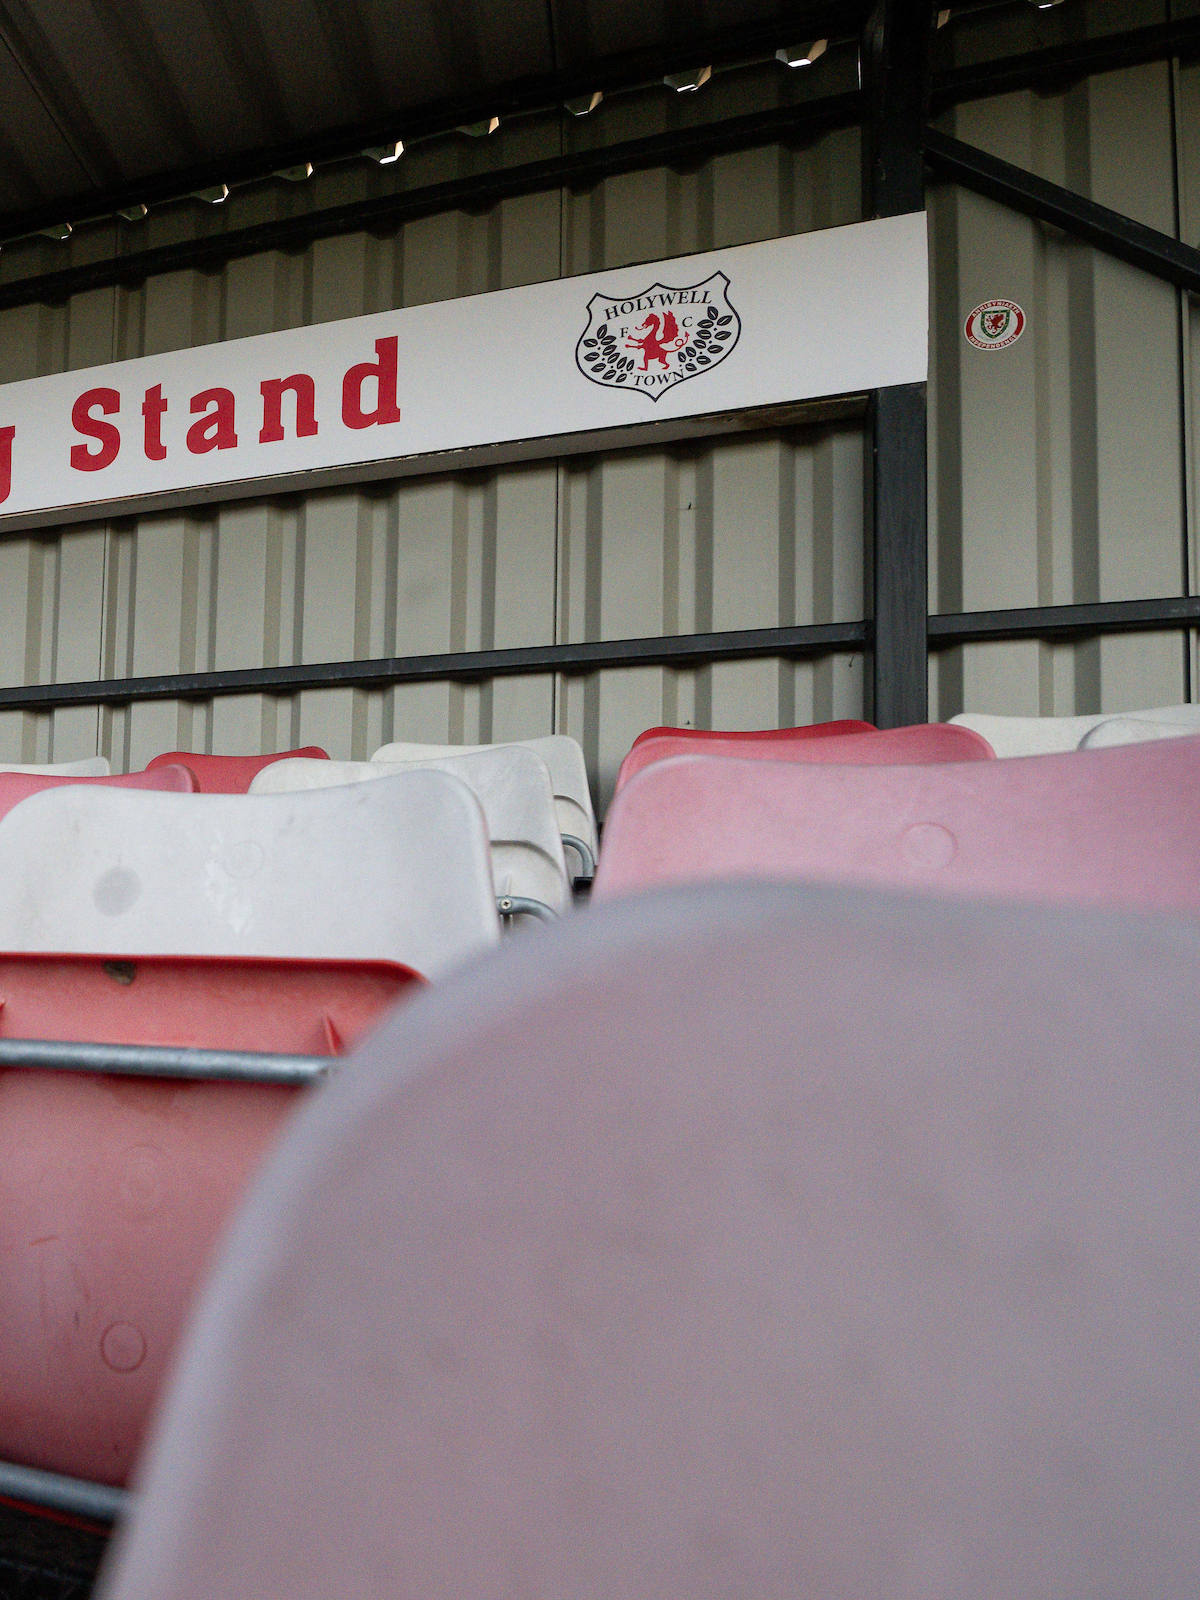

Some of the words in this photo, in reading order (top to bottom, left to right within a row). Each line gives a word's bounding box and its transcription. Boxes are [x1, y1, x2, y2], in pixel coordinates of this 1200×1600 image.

[604, 290, 712, 321] HOLYWELL
[620, 327, 629, 338] F
[682, 316, 693, 328] C
[969, 334, 1018, 349] INDEPENDENCE
[633, 368, 685, 386] TOWN
[70, 335, 401, 472] Stand
